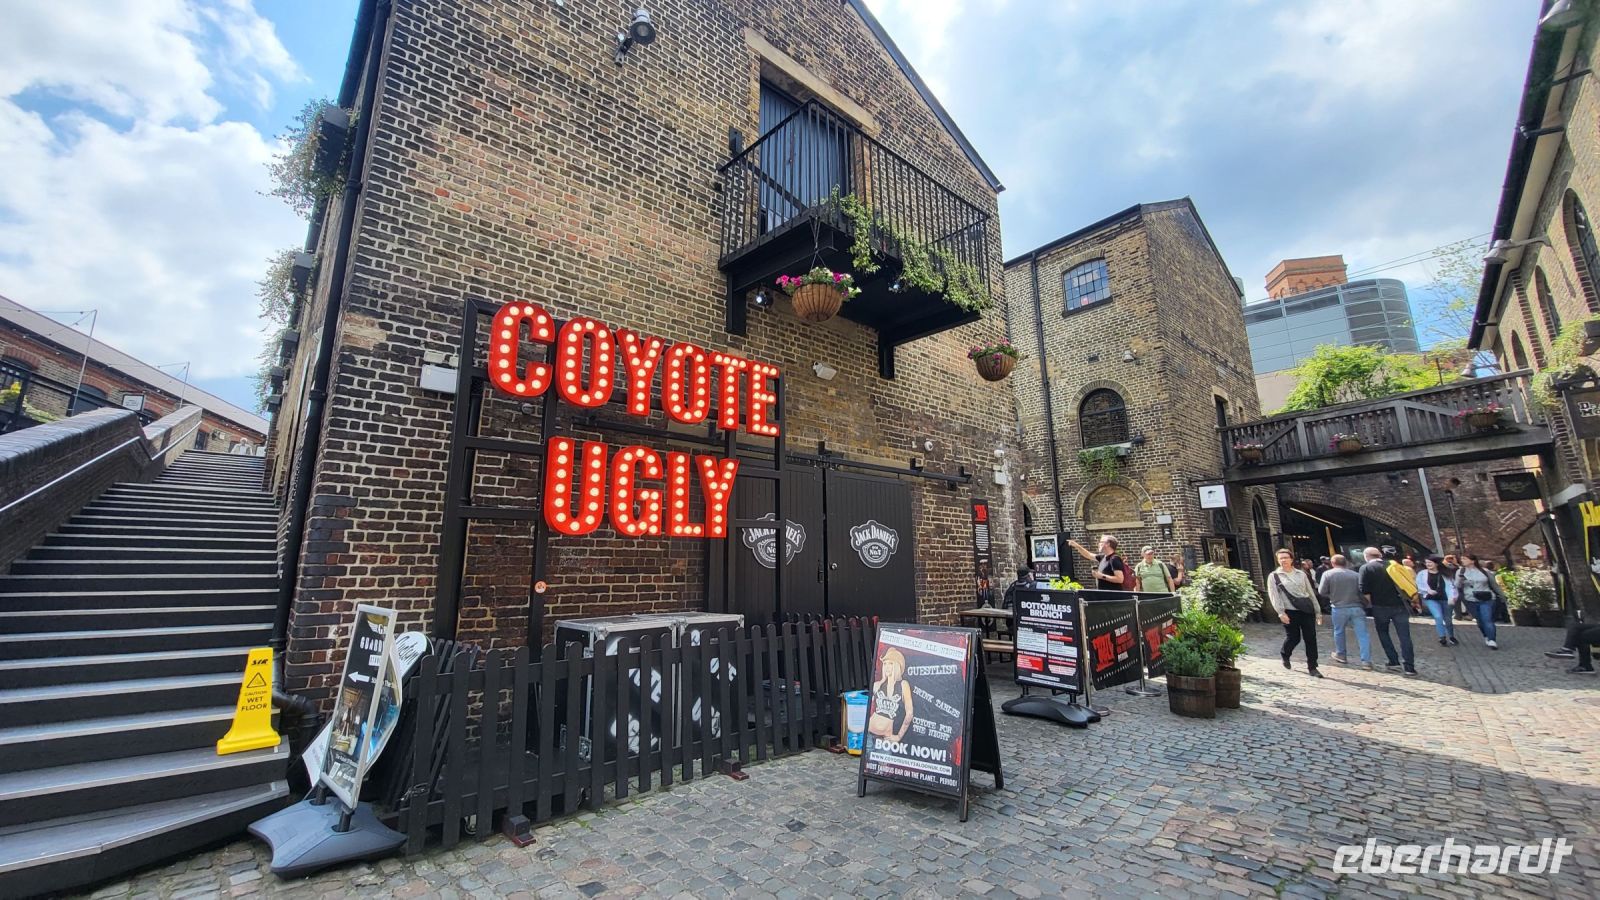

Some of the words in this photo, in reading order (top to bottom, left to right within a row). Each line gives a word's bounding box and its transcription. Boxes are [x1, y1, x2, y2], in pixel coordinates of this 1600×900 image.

[488, 301, 780, 437] COYOTE
[544, 436, 740, 538] UGLY
[855, 529, 871, 547] JACK
[1021, 601, 1072, 614] BOTTOMLESS
[1030, 609, 1063, 620] BRUNCH
[907, 664, 958, 677] GUESTLIST
[241, 704, 268, 712] FLOOR
[912, 685, 935, 703] DRINK
[934, 699, 961, 719] TABLES
[912, 716, 937, 730] COYOTE
[939, 723, 953, 735] FOR
[912, 724, 927, 735] THE
[928, 729, 951, 742] NIGHT
[875, 738, 909, 755] BOOK
[911, 744, 947, 763] NOW!
[866, 762, 878, 771] MOST
[894, 767, 904, 777] BAR
[904, 769, 911, 778] ON
[911, 771, 920, 780] THE
